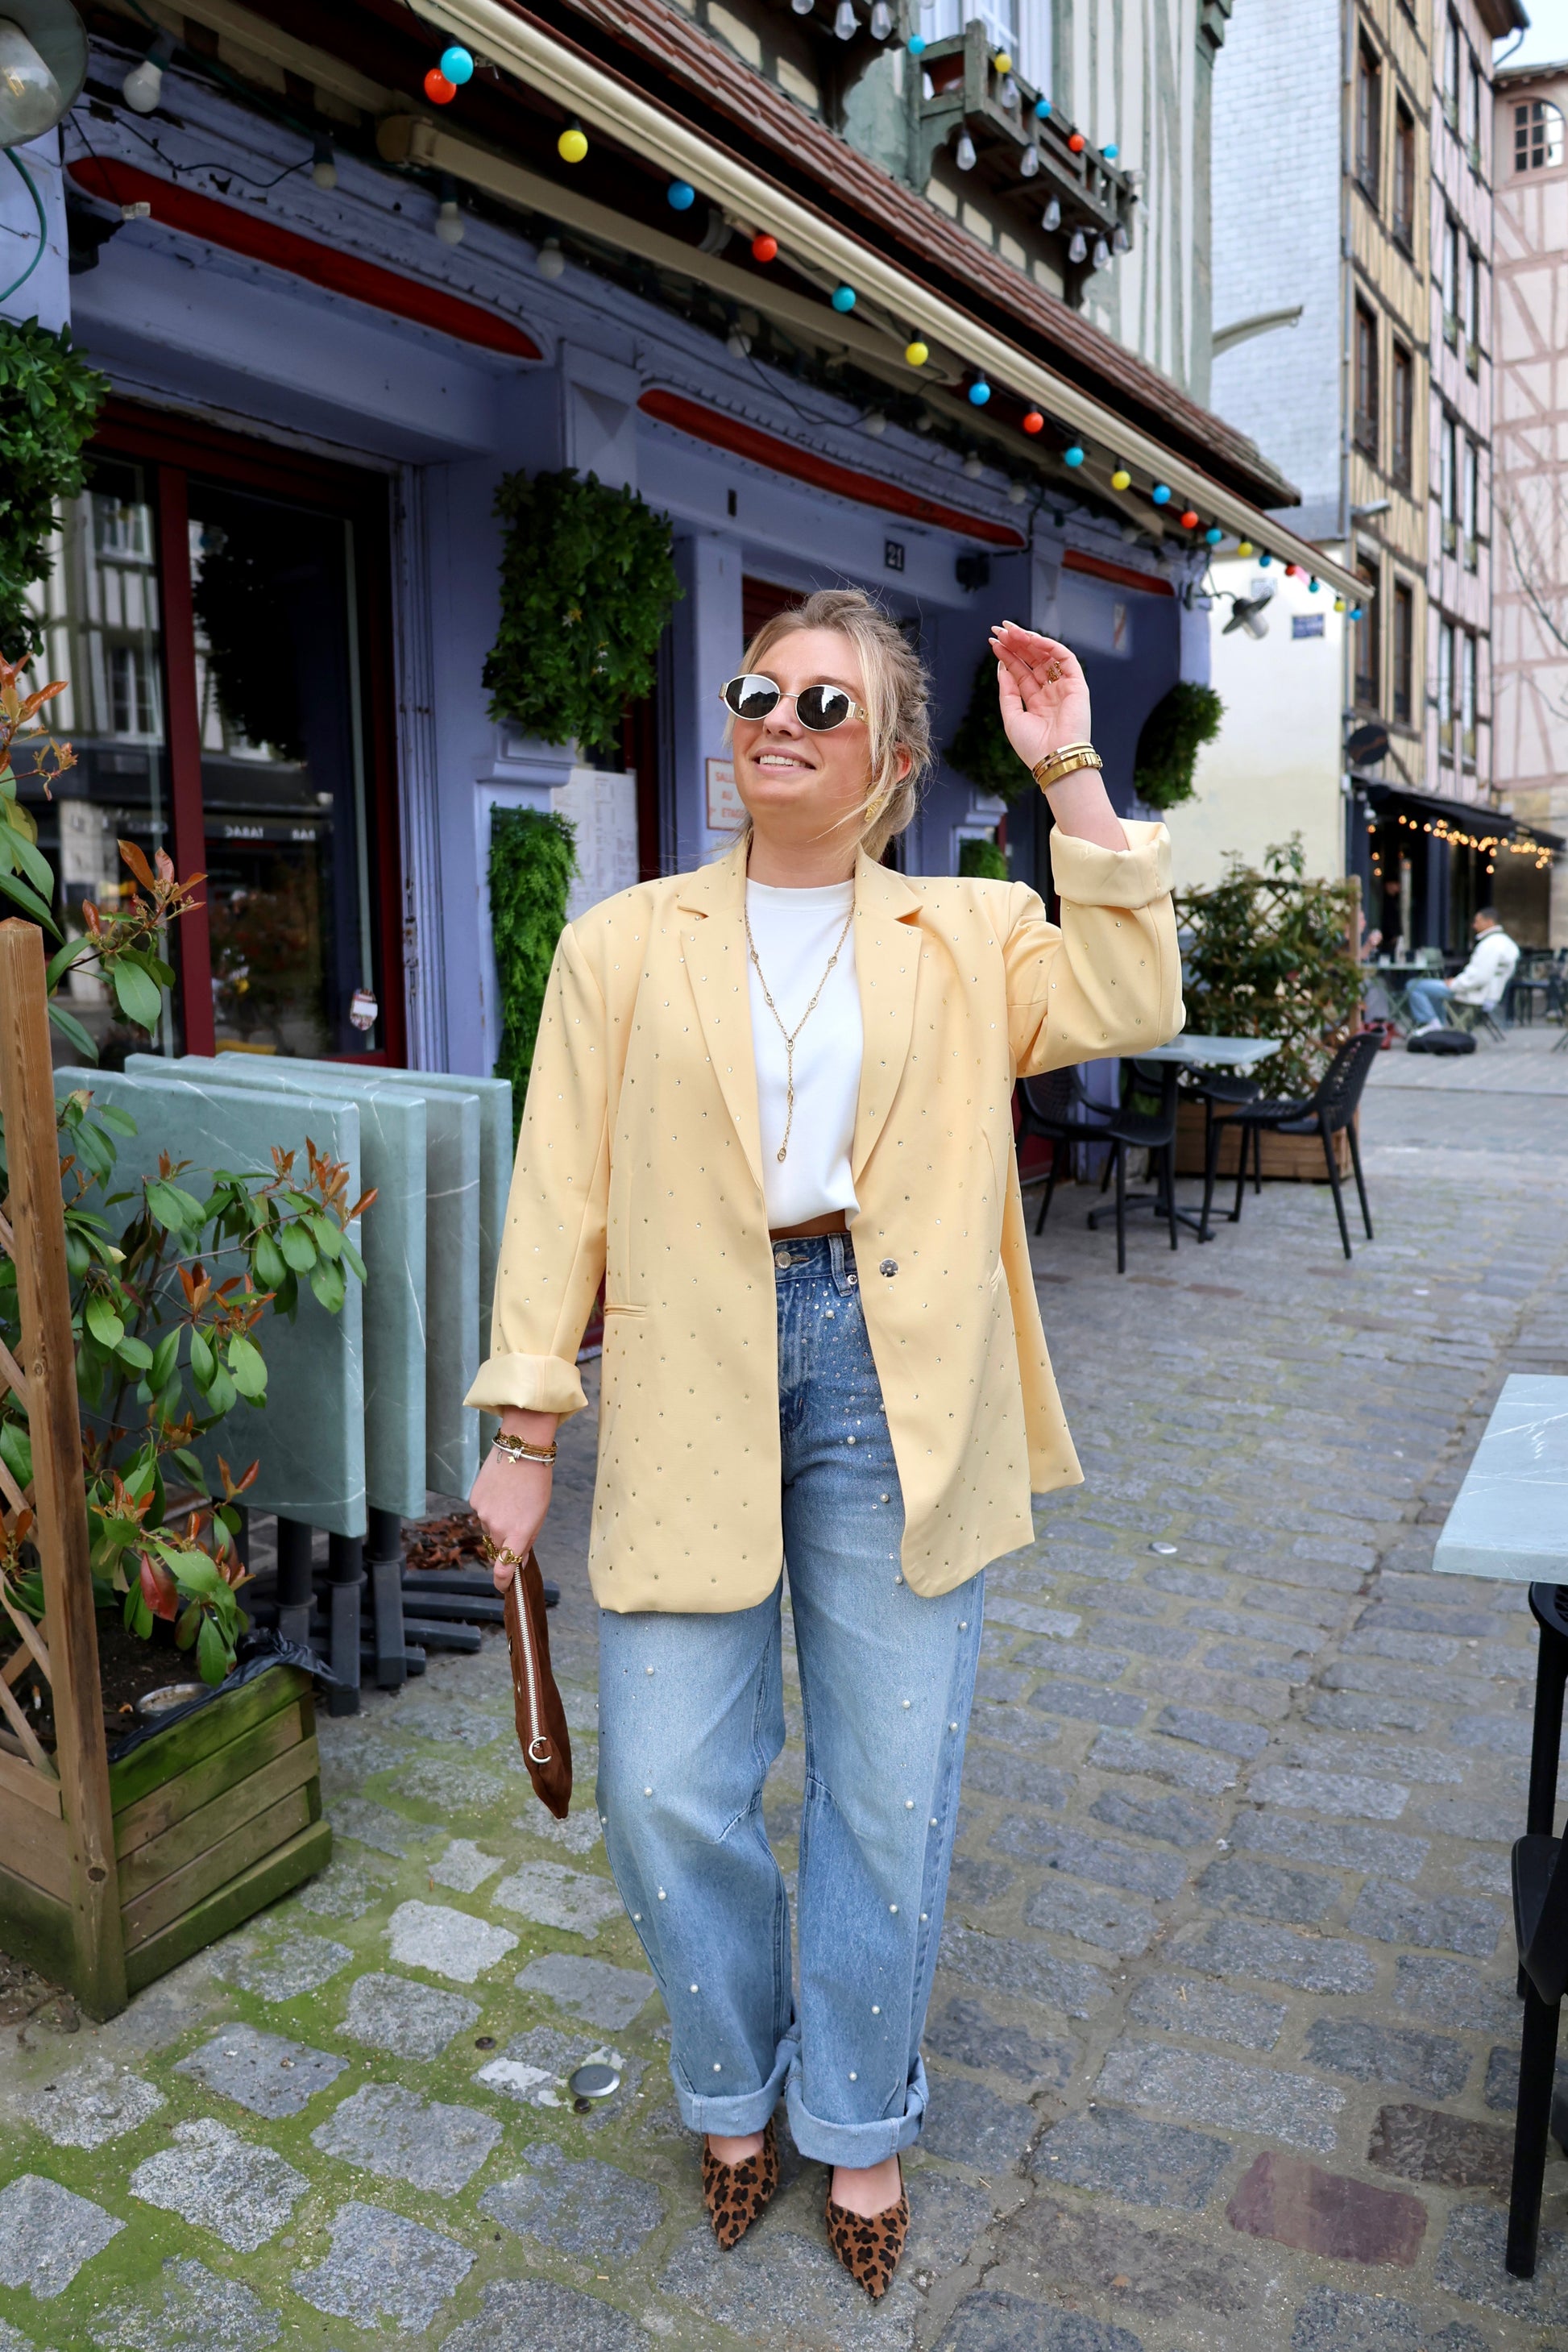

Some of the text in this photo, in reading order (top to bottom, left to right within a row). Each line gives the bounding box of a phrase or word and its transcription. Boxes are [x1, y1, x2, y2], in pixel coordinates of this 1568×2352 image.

[888, 544, 902, 567] 21
[715, 772, 735, 784] SALL
[722, 790, 732, 801] AU
